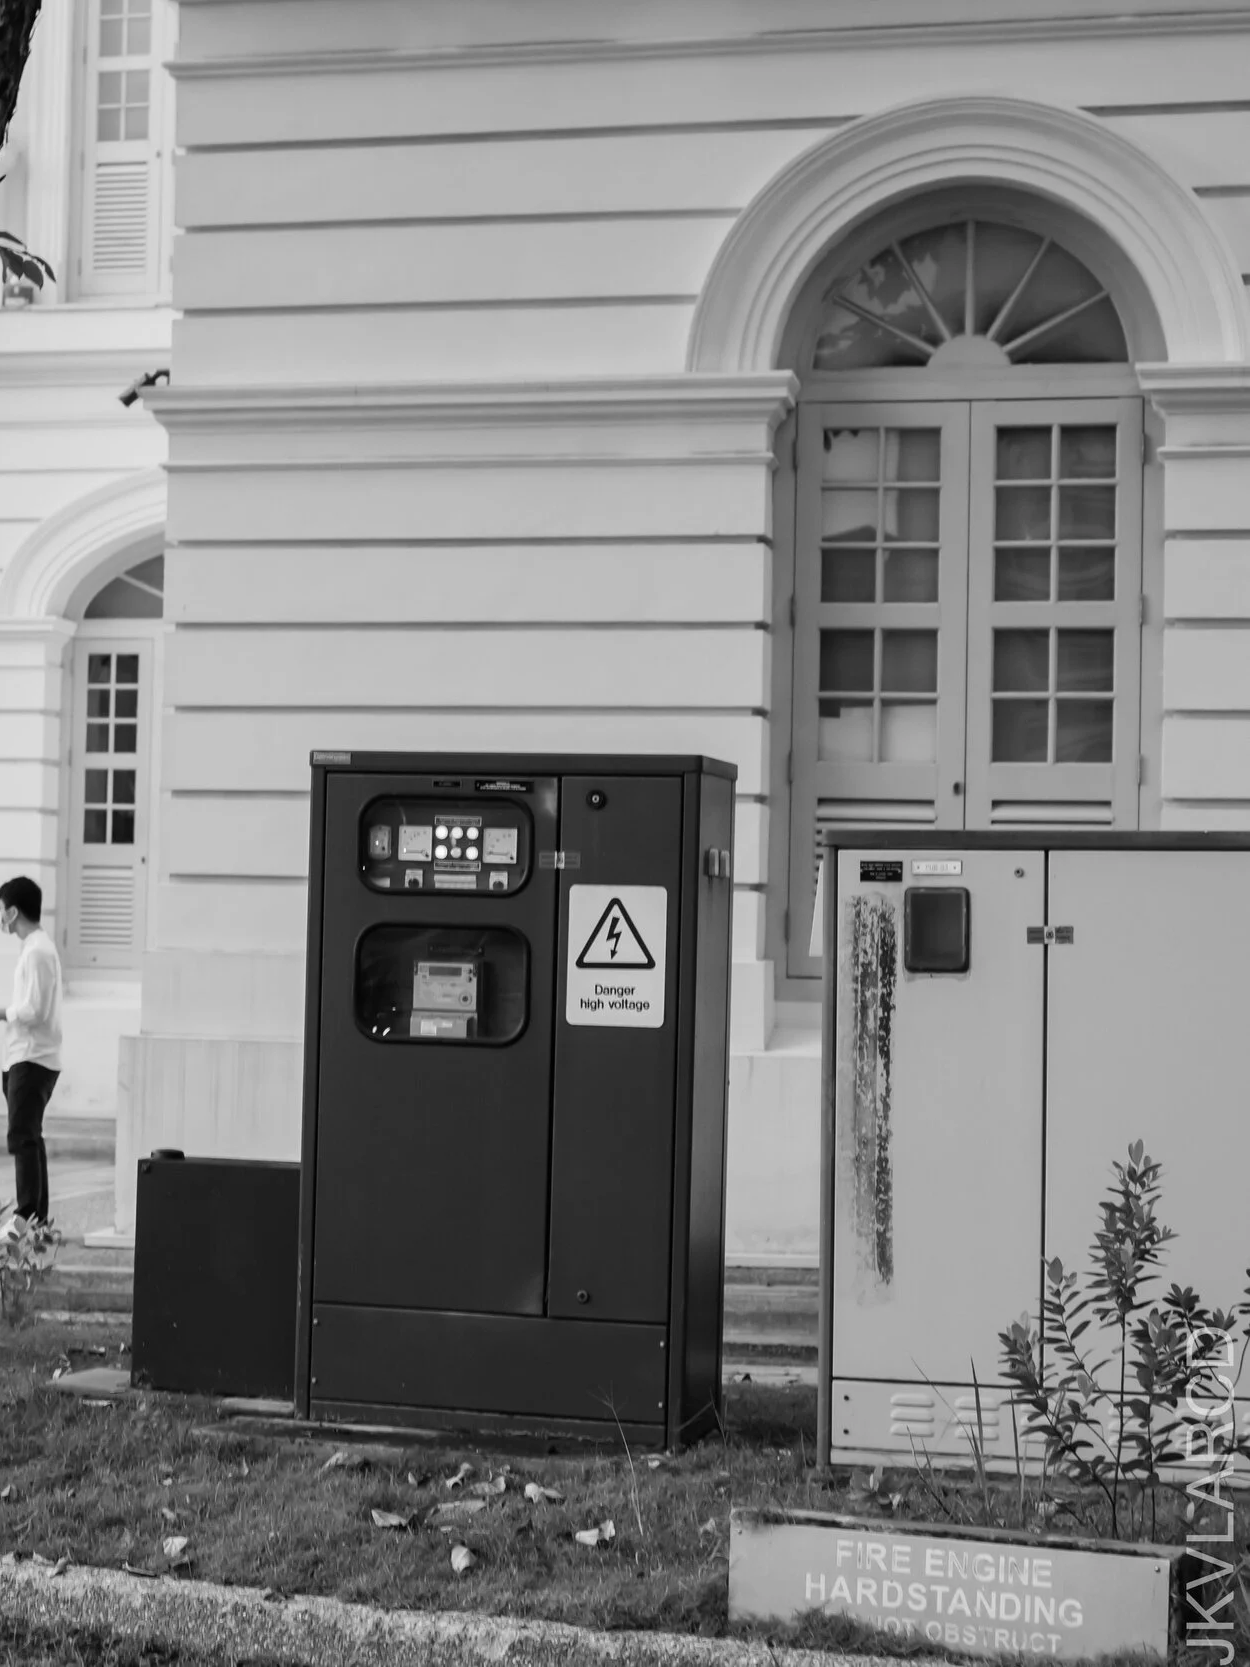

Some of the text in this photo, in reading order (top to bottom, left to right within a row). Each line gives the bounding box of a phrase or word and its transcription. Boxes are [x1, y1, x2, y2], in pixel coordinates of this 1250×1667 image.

[580, 998, 650, 1012] high voltage
[594, 984, 636, 998] Danger
[835, 1539, 1053, 1588] FIRE ENGINE
[804, 1572, 1084, 1628] HARDSTANDING
[924, 1620, 1062, 1654] OBSTRUCT
